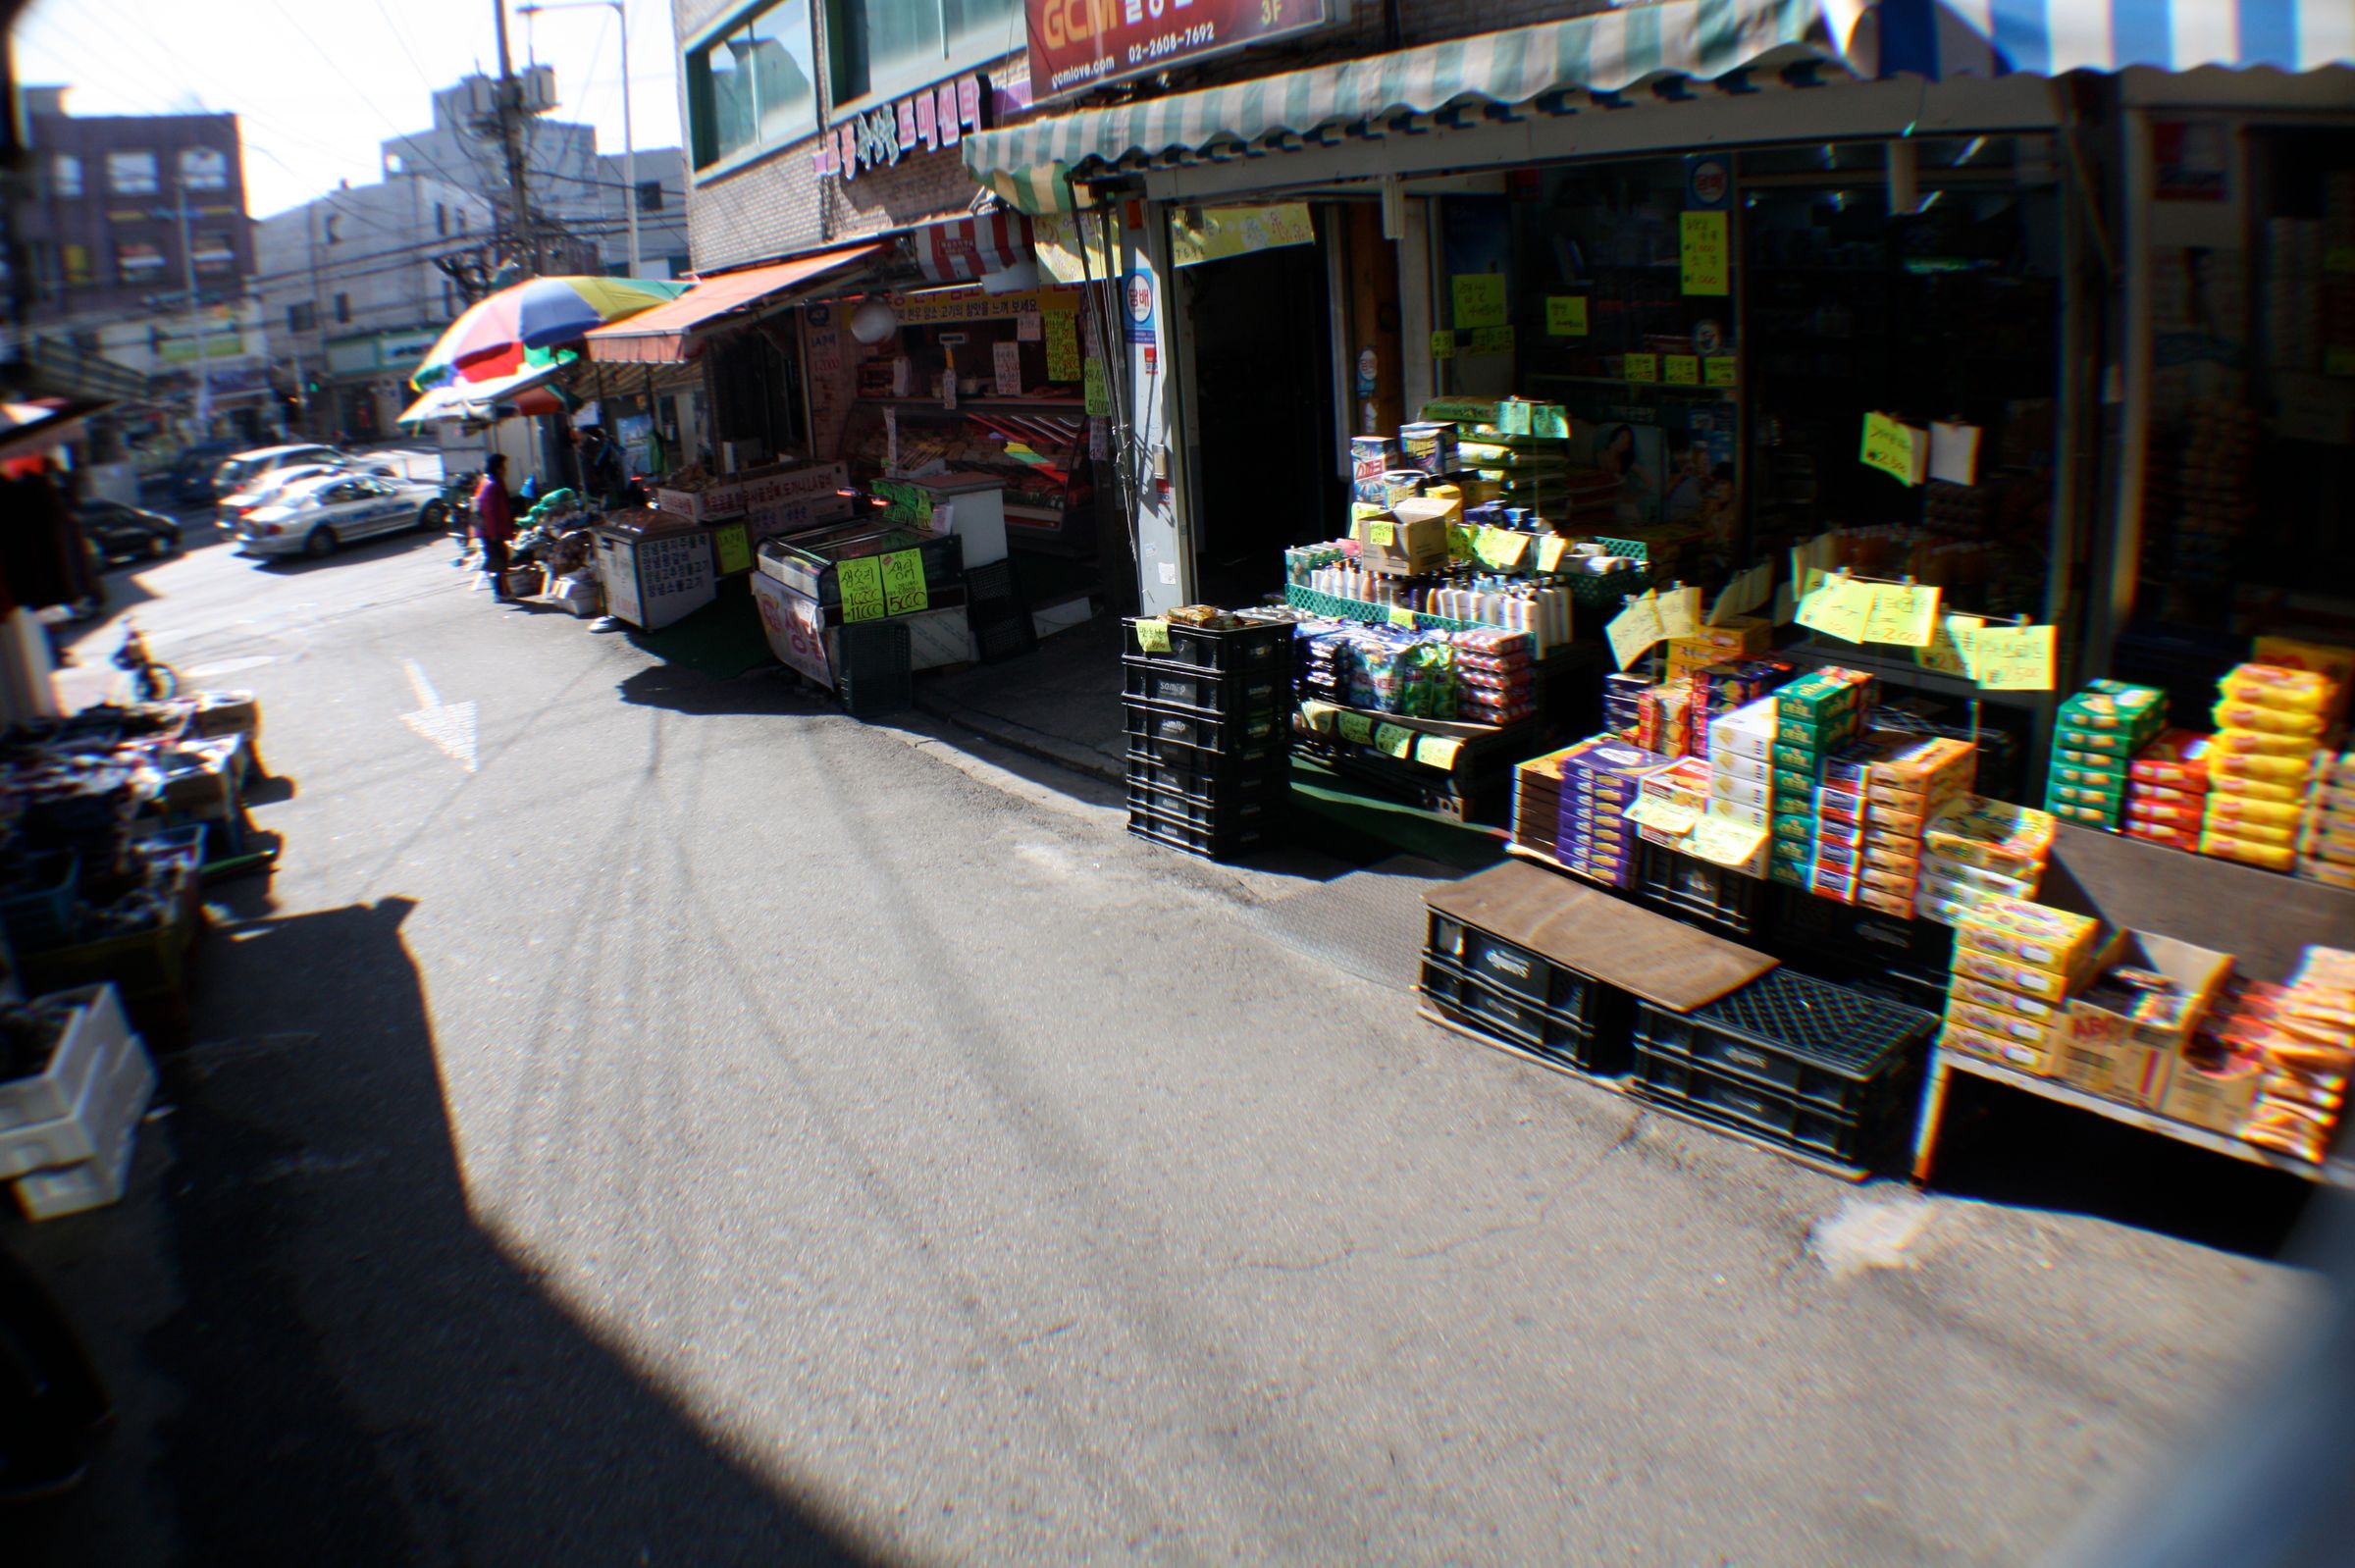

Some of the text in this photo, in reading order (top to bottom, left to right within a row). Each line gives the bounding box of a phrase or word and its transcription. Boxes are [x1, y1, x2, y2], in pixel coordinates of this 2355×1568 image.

[1128, 22, 1216, 63] 02-2608-7692
[1051, 54, 1116, 89] gcmlove.com
[1127, 287, 1150, 308] 담배
[841, 566, 875, 589] 생오리
